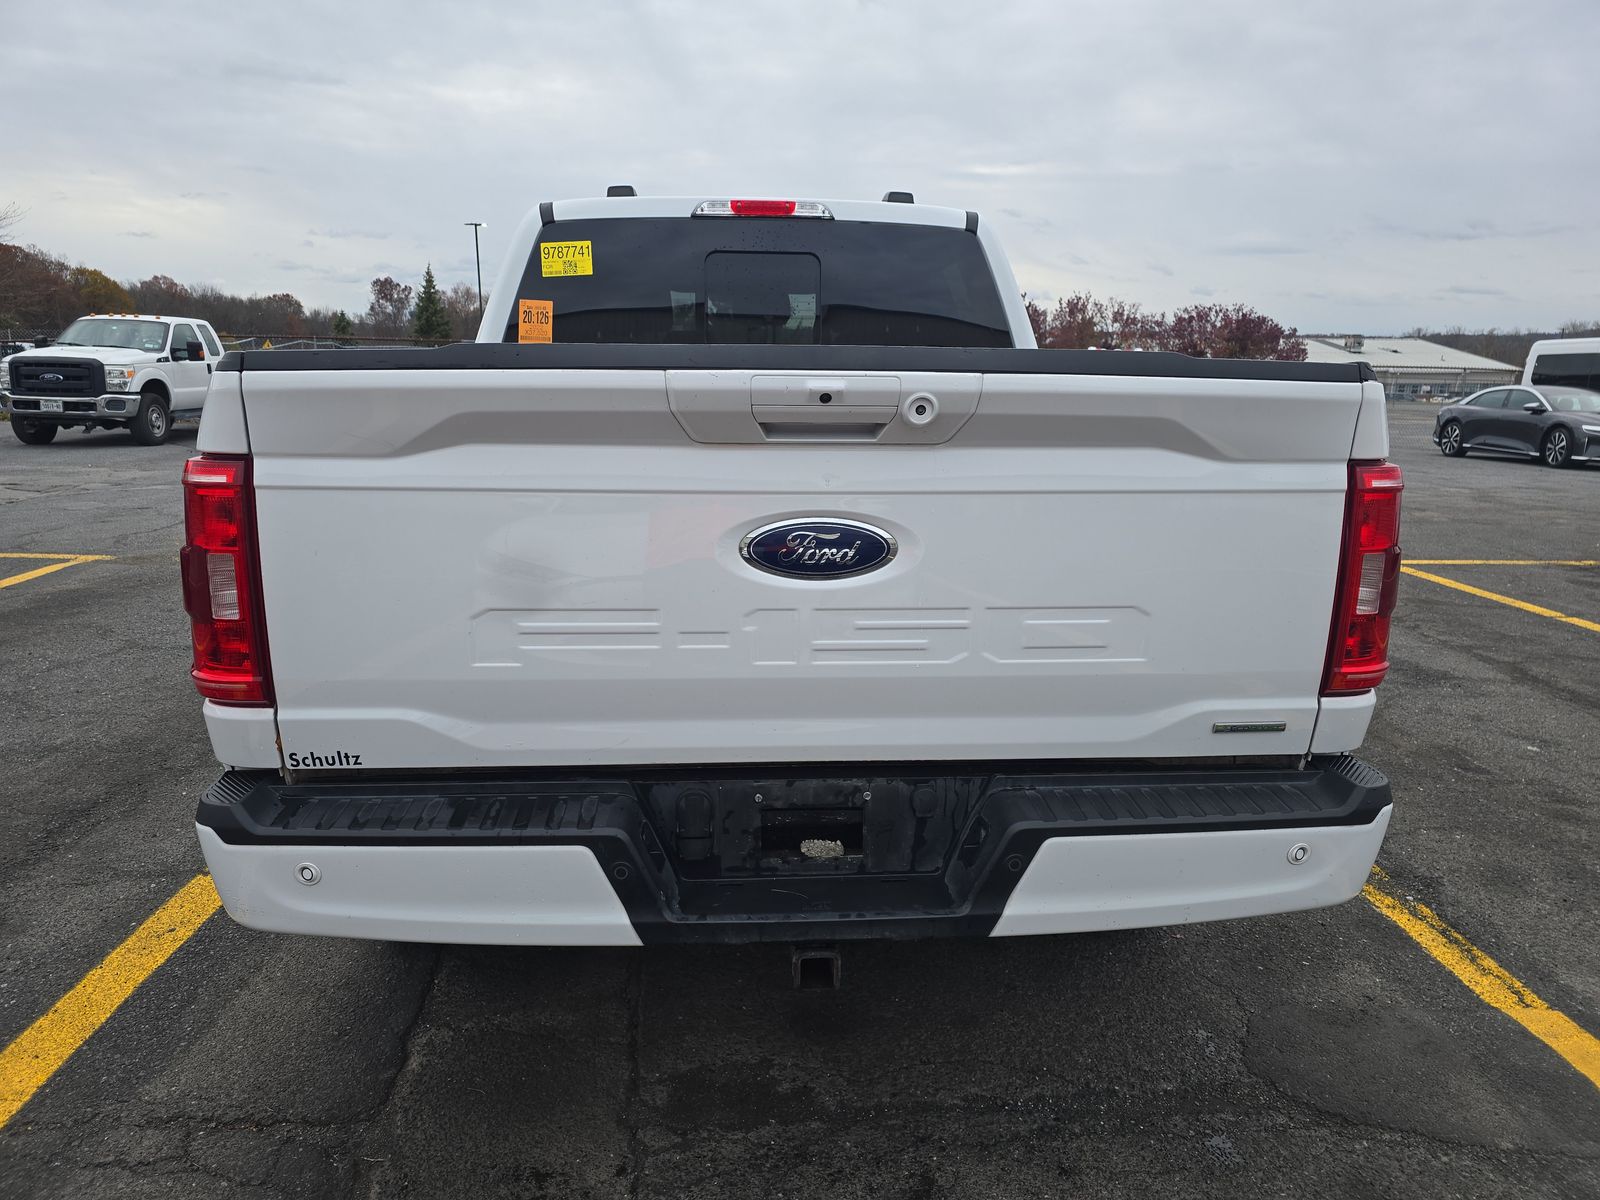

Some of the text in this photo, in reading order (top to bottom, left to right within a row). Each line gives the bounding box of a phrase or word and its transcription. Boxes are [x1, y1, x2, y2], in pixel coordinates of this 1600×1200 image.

[543, 245, 591, 259] 9787741
[523, 310, 549, 325] 20:126
[778, 531, 861, 565] Ford
[288, 750, 363, 768] Schultz
